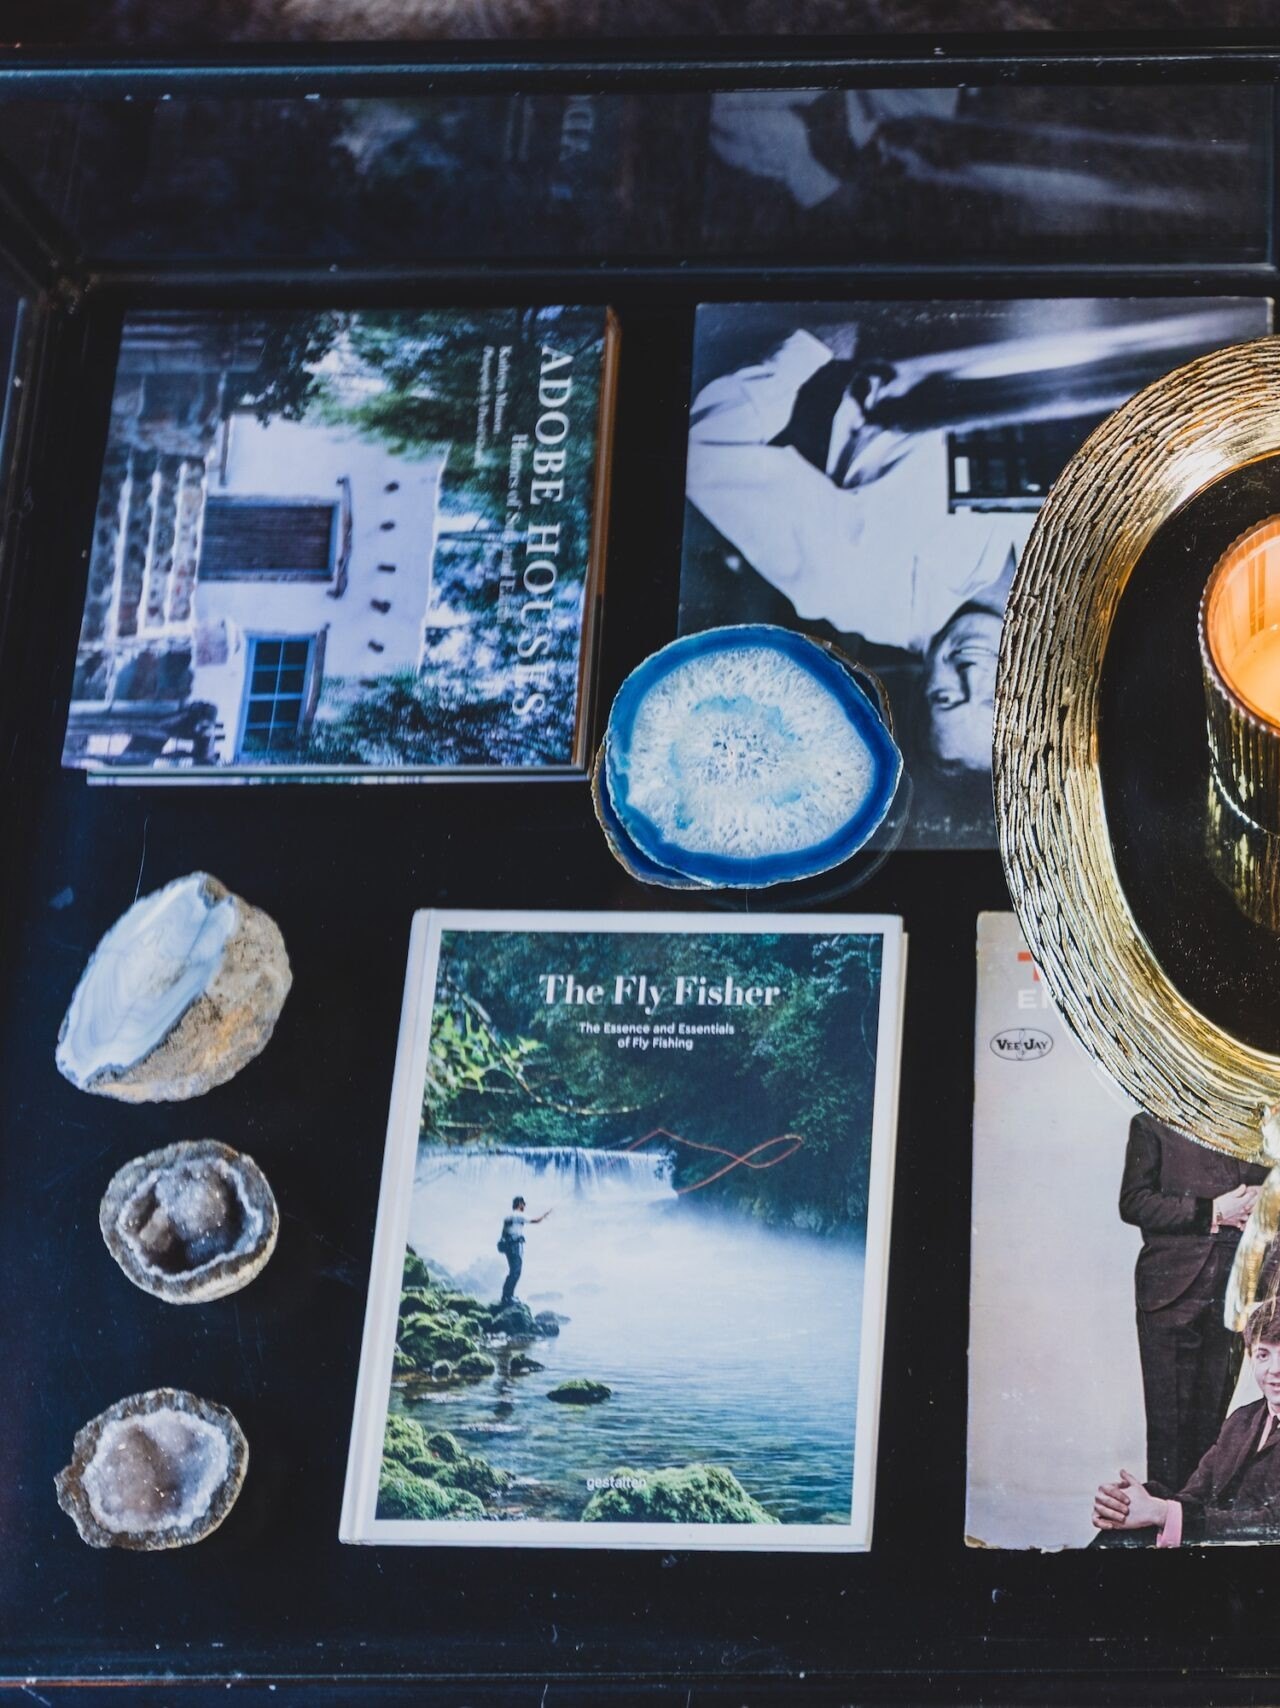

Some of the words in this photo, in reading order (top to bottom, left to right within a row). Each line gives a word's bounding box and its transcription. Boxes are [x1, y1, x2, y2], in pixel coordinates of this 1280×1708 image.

[530, 344, 575, 505] ADOBE
[511, 522, 561, 716] HOUSES
[538, 973, 604, 1005] The
[611, 974, 667, 1016] Fly
[673, 975, 781, 1006] Fisher
[579, 1021, 600, 1034] The
[603, 1022, 650, 1035] Essence
[653, 1022, 676, 1035] and
[678, 1022, 735, 1035] Essentials
[617, 1035, 631, 1049] of
[632, 1036, 649, 1051] Fly
[652, 1036, 694, 1051] Fishing
[586, 1476, 648, 1492] gestalten
